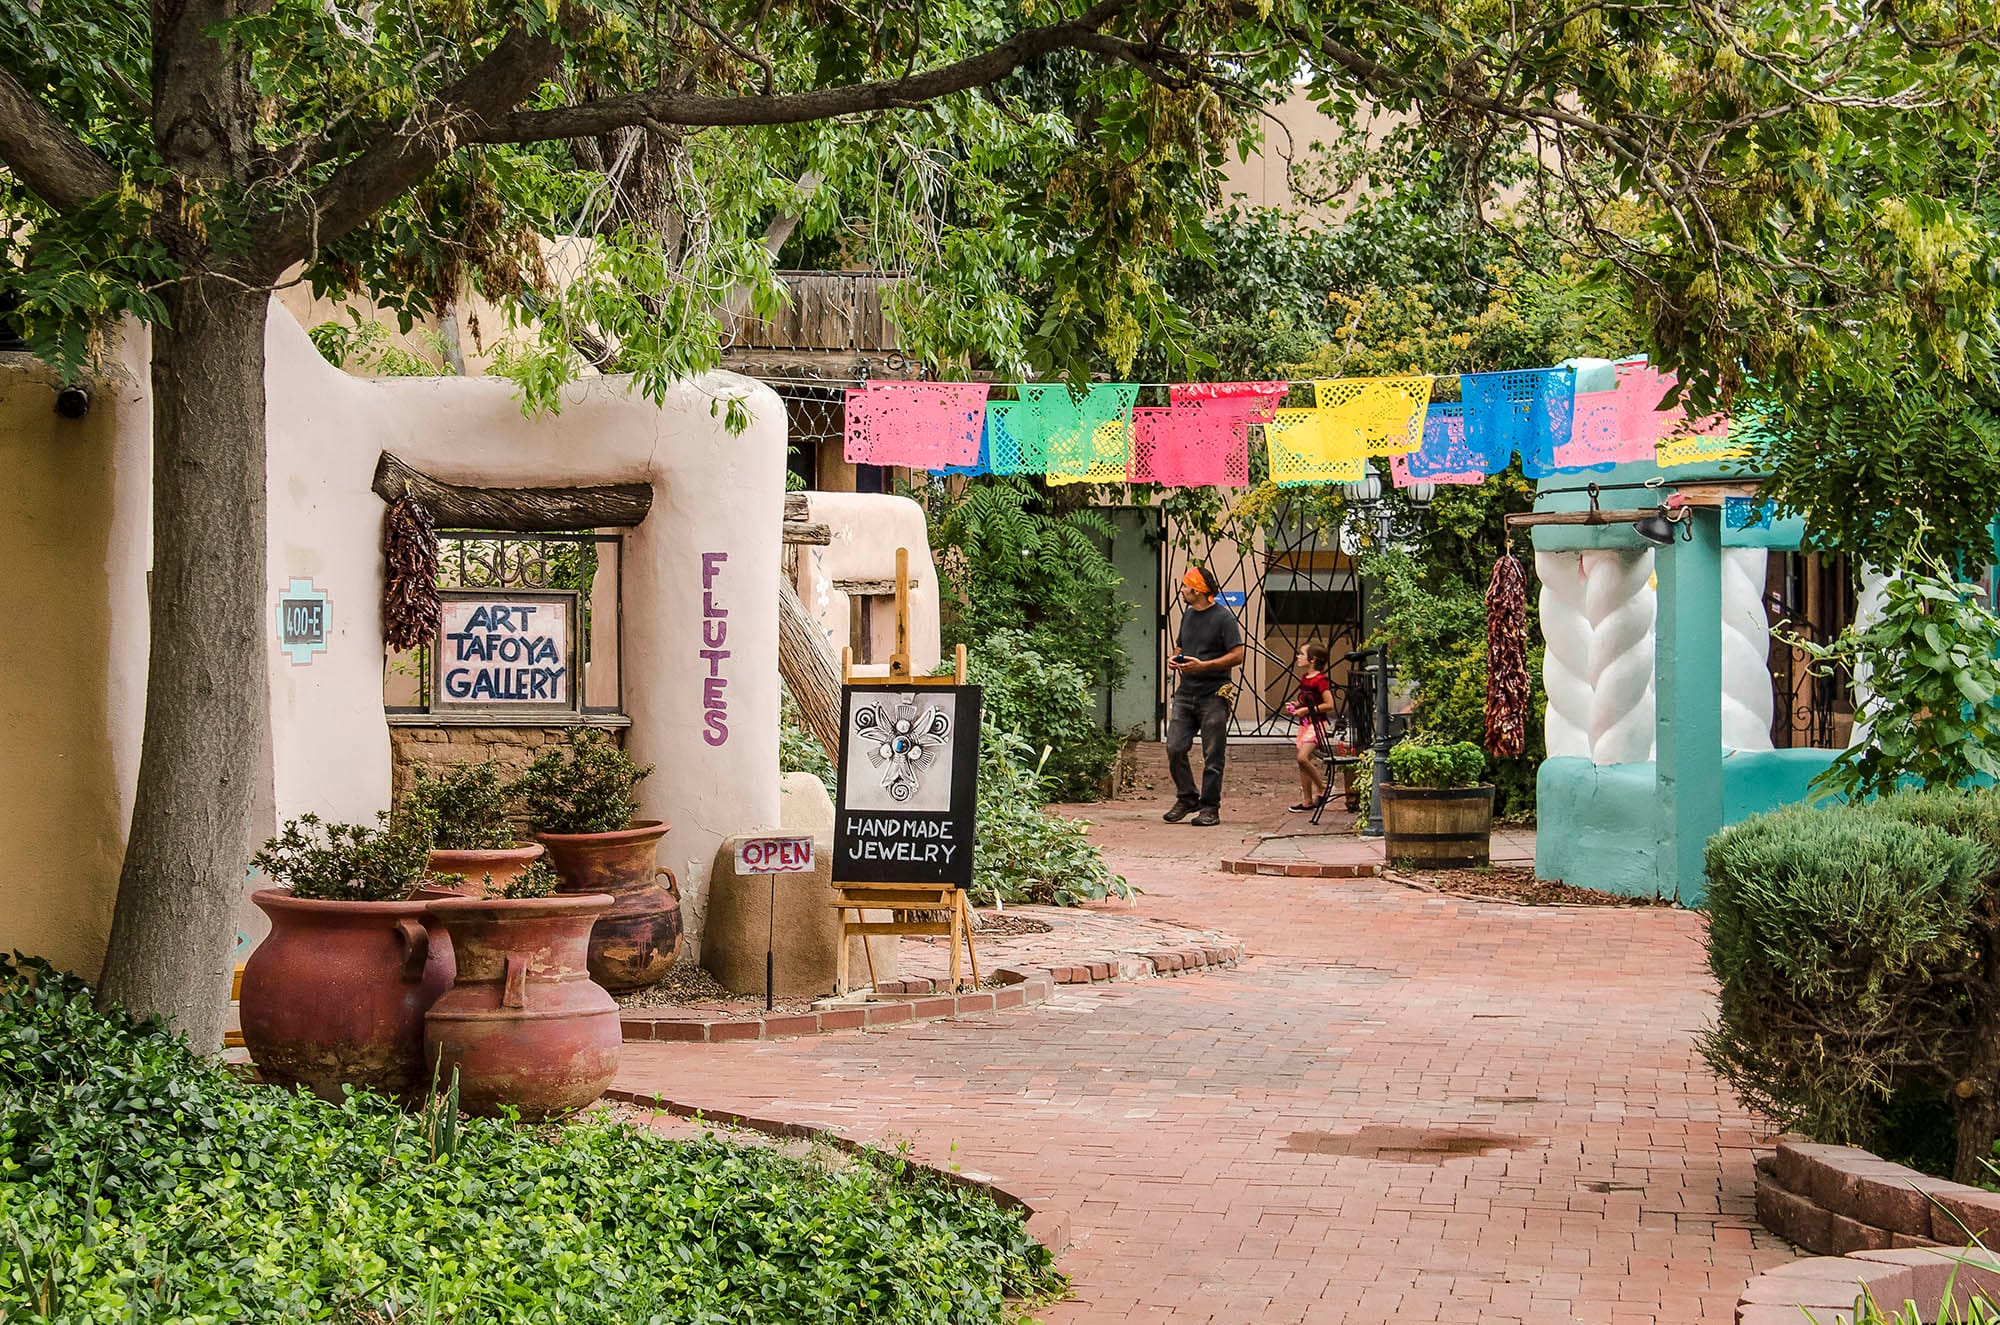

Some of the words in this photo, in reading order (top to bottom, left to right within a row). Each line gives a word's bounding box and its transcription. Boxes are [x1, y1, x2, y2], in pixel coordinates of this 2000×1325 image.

[286, 606, 322, 637] 400-E
[464, 605, 537, 633] ART
[447, 633, 559, 666] TAFOYA
[700, 552, 731, 747] FLUTES
[446, 666, 566, 699] GALLERY
[742, 841, 811, 865] OPEN
[848, 840, 956, 864] JEWELRY
